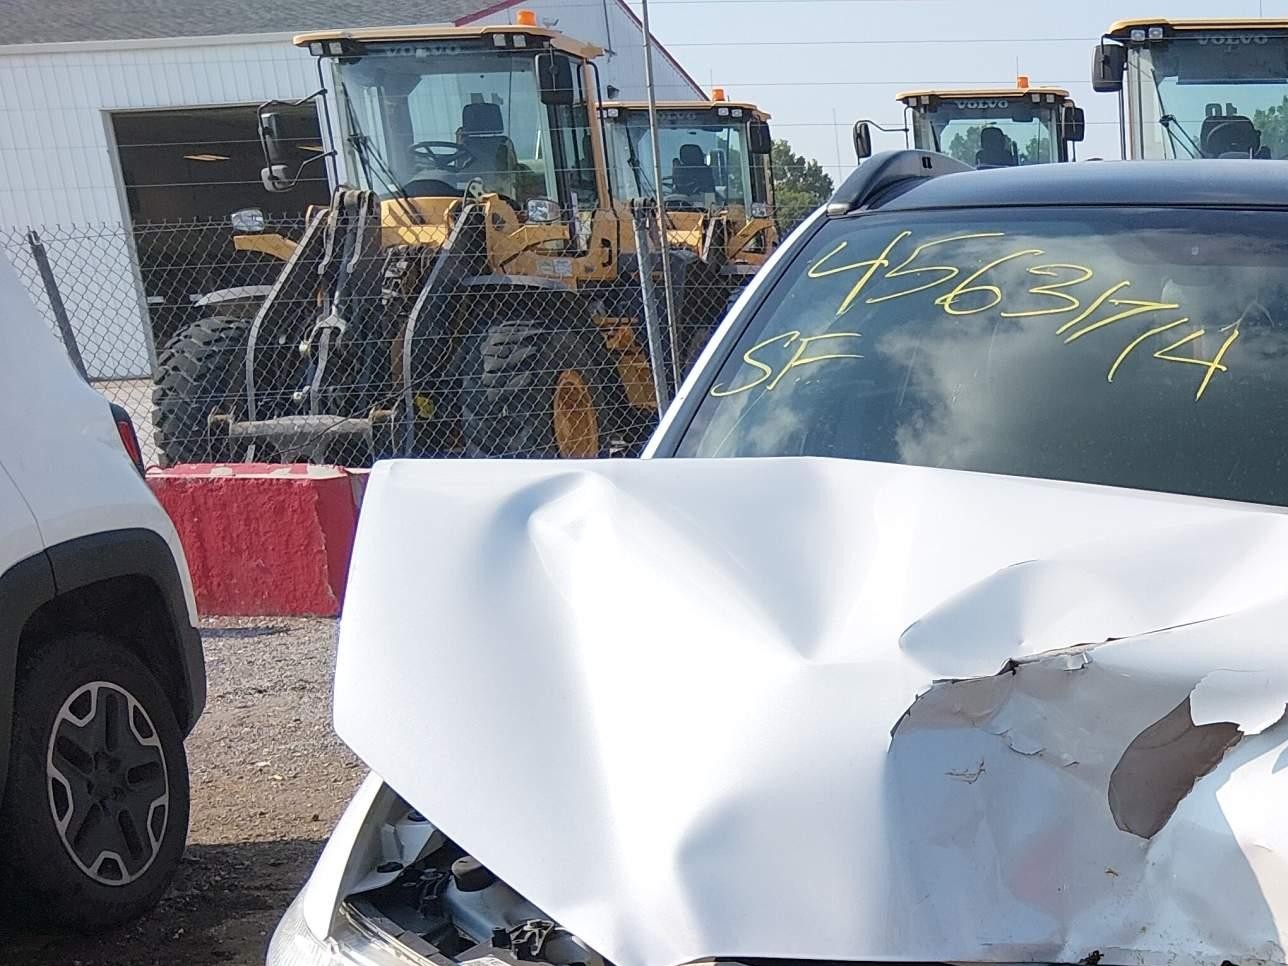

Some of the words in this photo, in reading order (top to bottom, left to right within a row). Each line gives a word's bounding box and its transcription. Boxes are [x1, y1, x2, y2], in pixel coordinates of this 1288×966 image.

[1198, 34, 1268, 45] VOLVO
[955, 100, 1008, 109] VOLVO
[711, 331, 865, 397] SF
